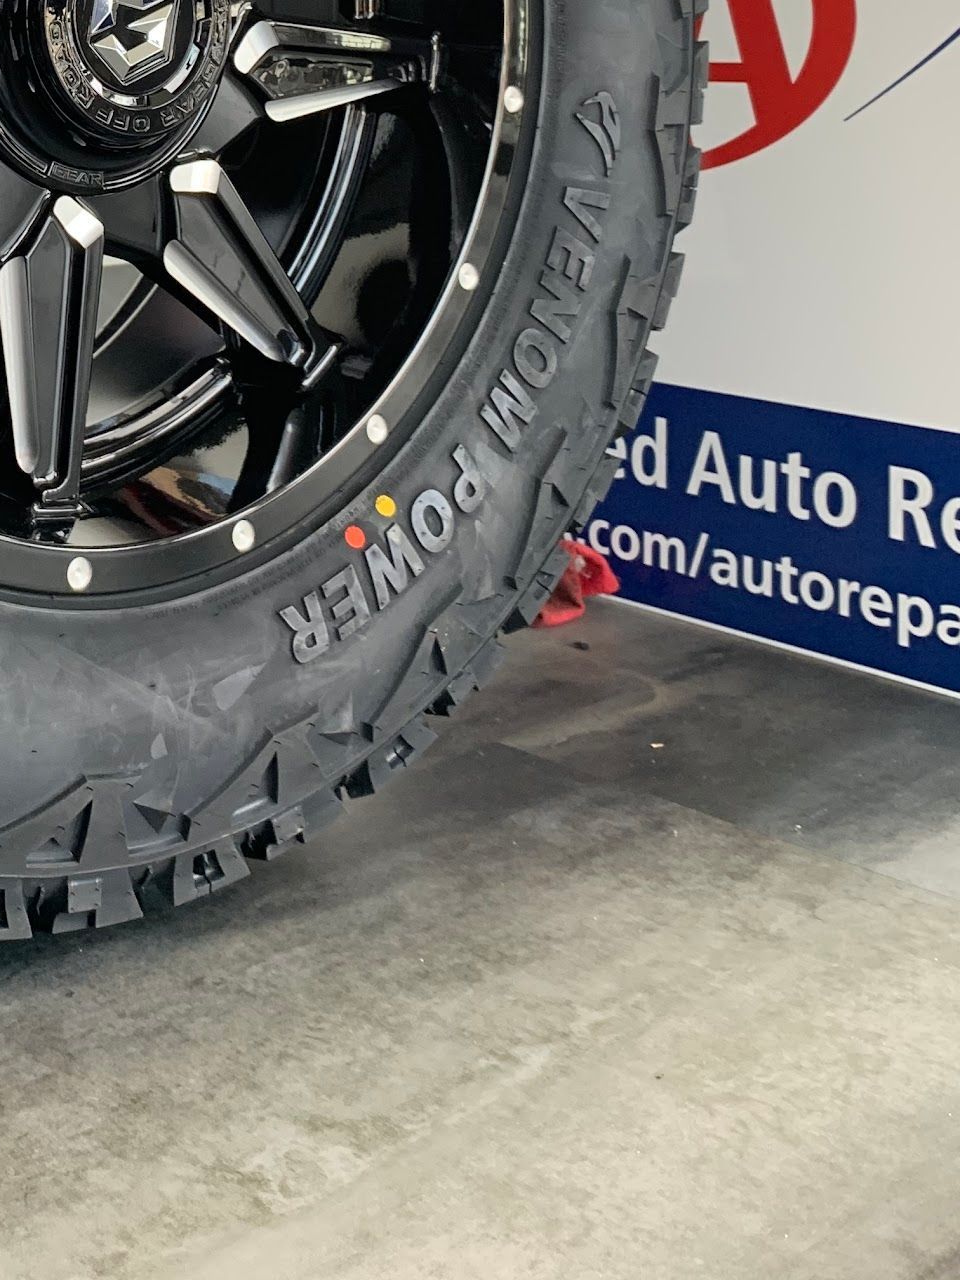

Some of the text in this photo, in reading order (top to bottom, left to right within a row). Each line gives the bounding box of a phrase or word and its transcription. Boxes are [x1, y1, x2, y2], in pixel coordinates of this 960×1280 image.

[53, 163, 102, 186] GEAR
[479, 186, 611, 454] VENOM
[278, 443, 488, 665] POWER
[686, 430, 858, 529] Auto
